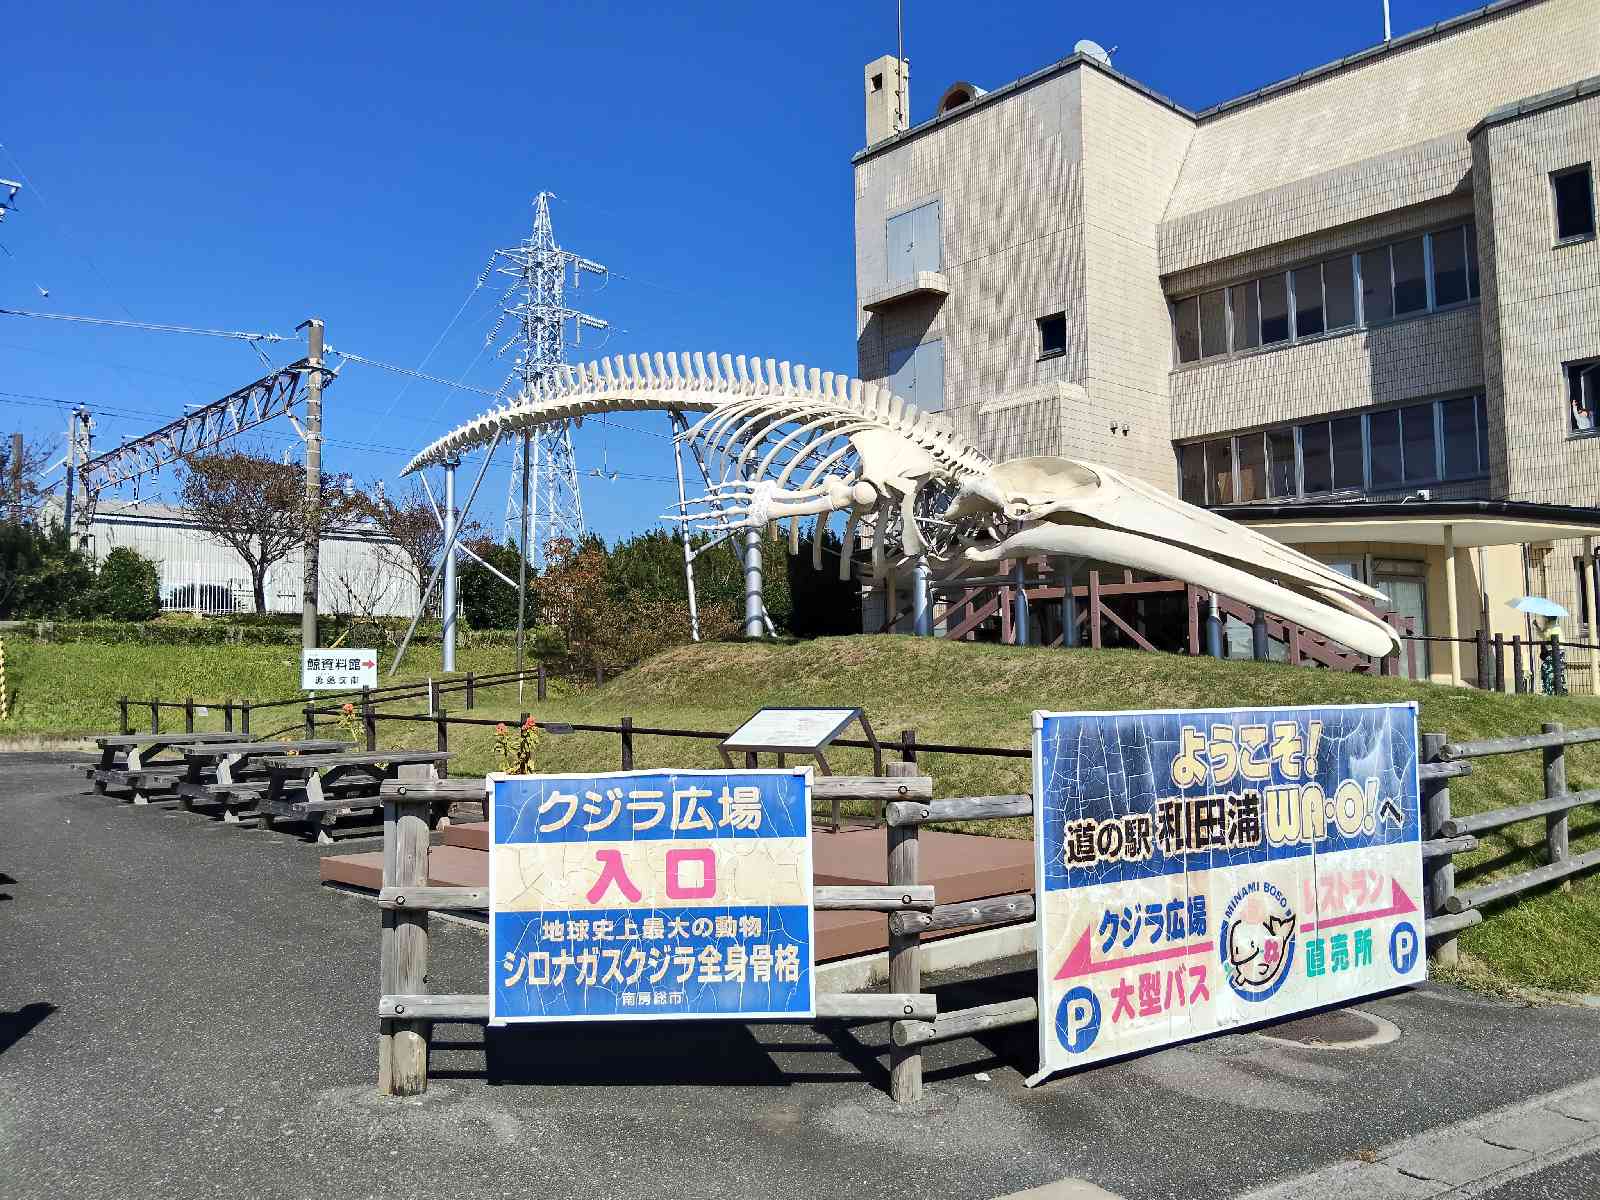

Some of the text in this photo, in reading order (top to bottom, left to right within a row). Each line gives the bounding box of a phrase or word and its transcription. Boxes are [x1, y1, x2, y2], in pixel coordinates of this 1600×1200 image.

[1171, 720, 1322, 788] ようこそ!
[538, 785, 762, 833] クジラ広場
[586, 848, 716, 904] 入口
[1225, 881, 1287, 918] MINAMI BOSO
[542, 916, 762, 941] 地球史上最大の動物
[1099, 895, 1207, 954] クジラ広場
[503, 944, 800, 987] シロナガスクジラ全身骨格
[1305, 929, 1374, 977] 直売所
[1394, 932, 1415, 968] P
[621, 991, 683, 1005] 南房総市
[1111, 965, 1210, 1023] 大型バス
[1066, 1000, 1093, 1046] P
